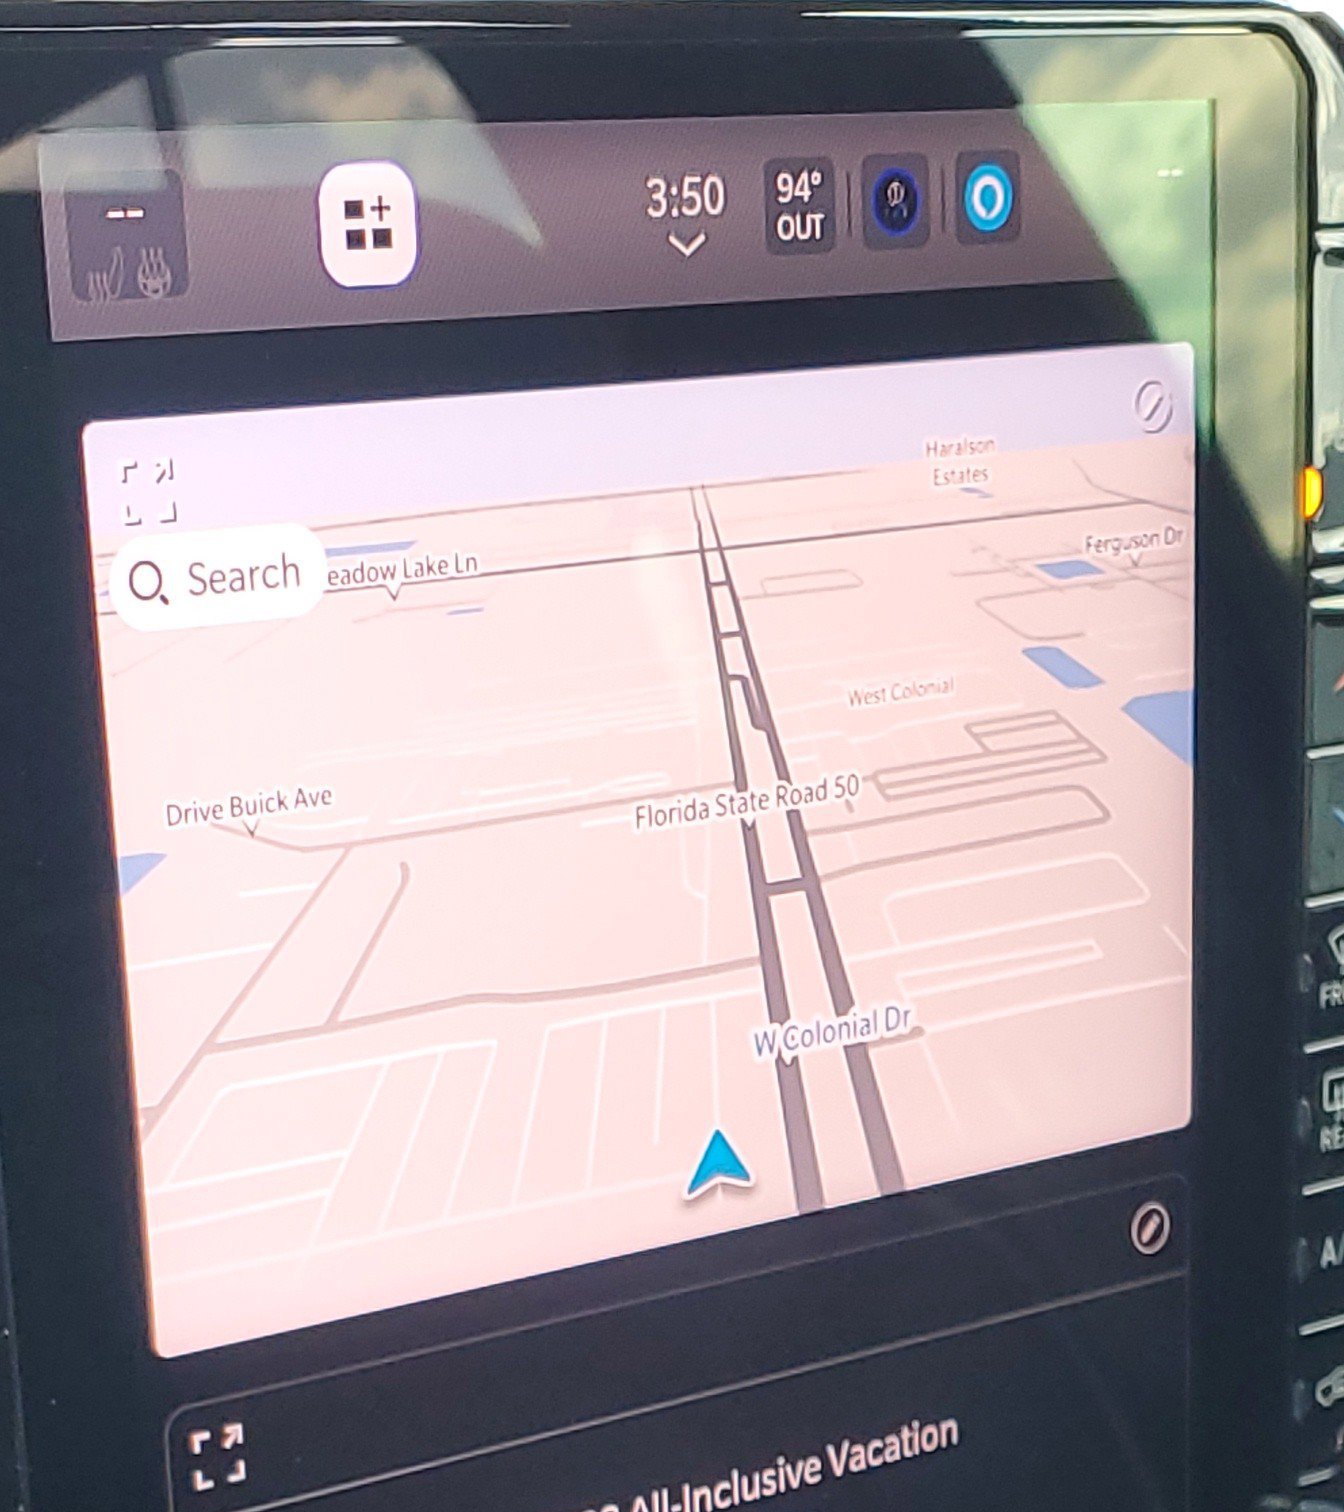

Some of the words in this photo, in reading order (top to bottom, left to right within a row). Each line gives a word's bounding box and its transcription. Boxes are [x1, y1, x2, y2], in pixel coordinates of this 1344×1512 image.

[645, 173, 725, 219] 3:50
[776, 212, 826, 241] OUT
[933, 466, 989, 486] Estates
[1085, 531, 1159, 556] Ferguson
[1163, 525, 1184, 547] Dr
[187, 552, 302, 597] Search
[327, 560, 397, 586] eadow
[402, 556, 451, 580] Lake
[454, 551, 479, 574] Ln
[848, 685, 888, 708] West
[890, 676, 956, 702] Colonial
[166, 800, 225, 827] Drive
[229, 789, 289, 818] Buick
[293, 786, 334, 812] Ave
[634, 799, 710, 831] Florida
[714, 790, 771, 819] State
[775, 777, 828, 809] Road
[833, 772, 861, 800] 50
[754, 1027, 783, 1058] W
[783, 1008, 880, 1052] Colonial
[883, 1004, 912, 1034] Dr
[825, 1415, 960, 1479] Vacation
